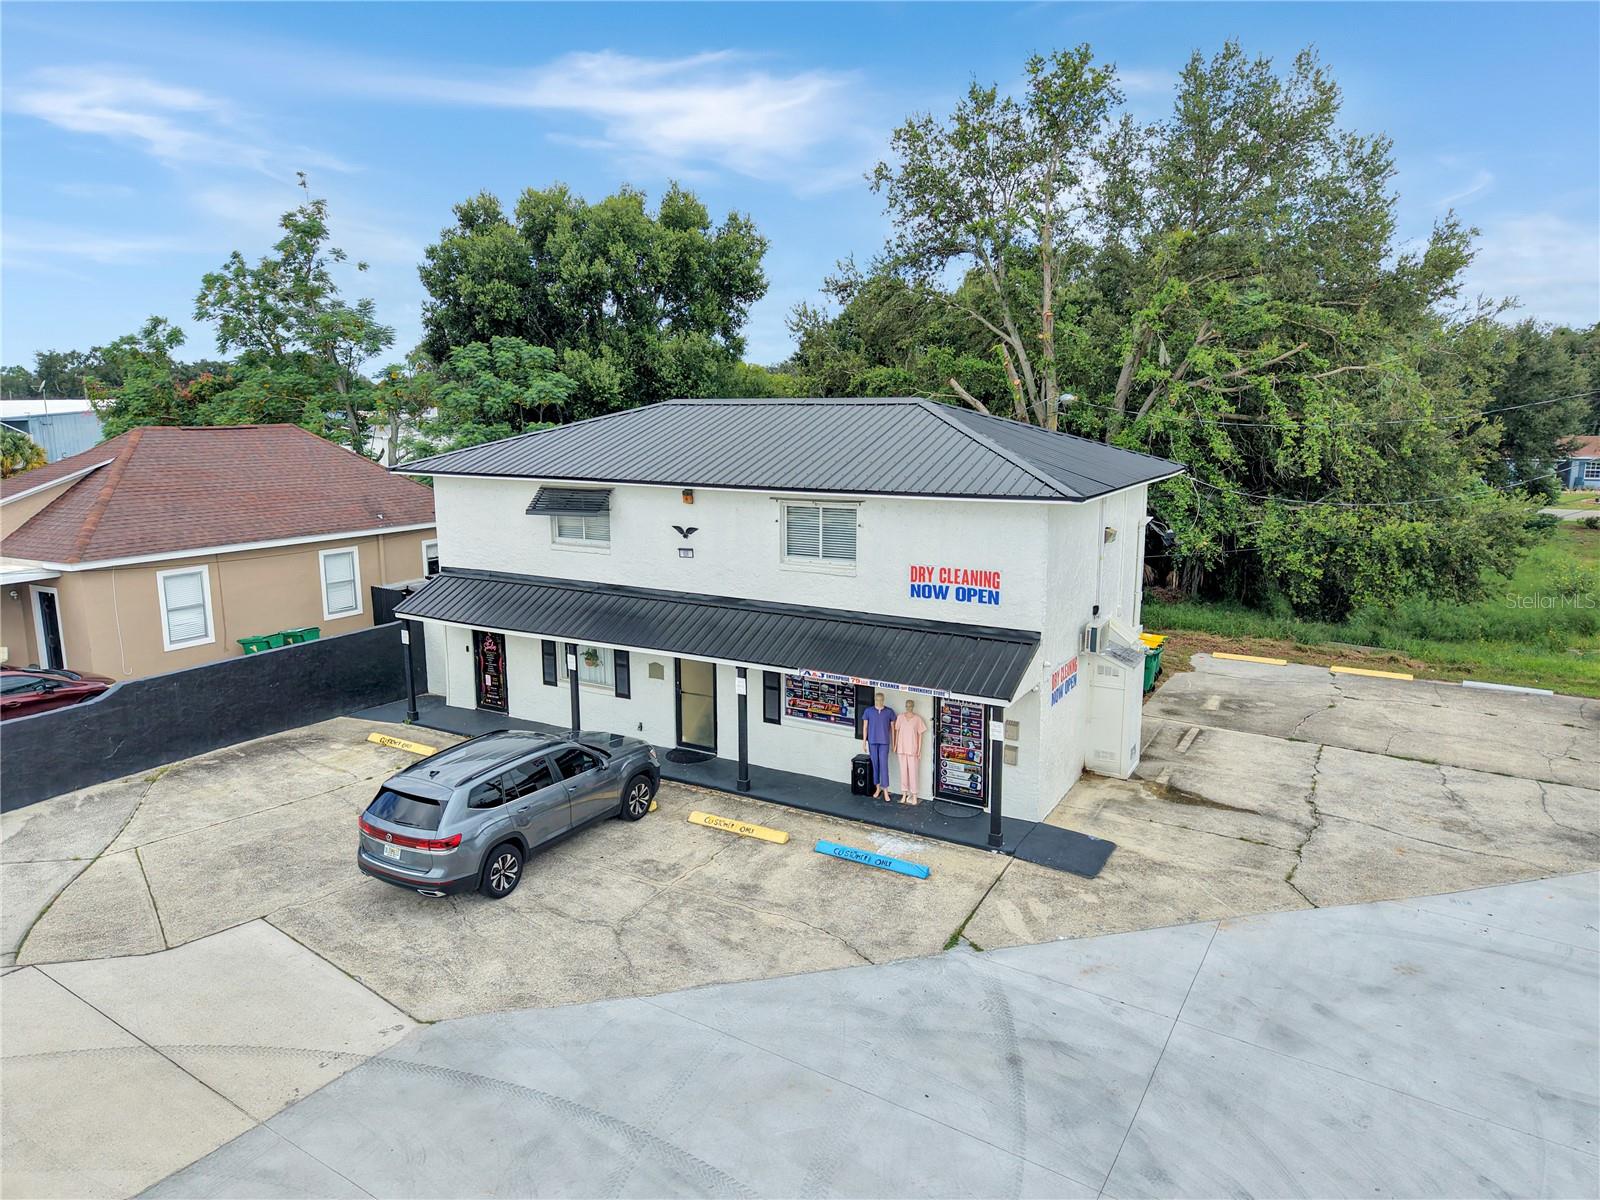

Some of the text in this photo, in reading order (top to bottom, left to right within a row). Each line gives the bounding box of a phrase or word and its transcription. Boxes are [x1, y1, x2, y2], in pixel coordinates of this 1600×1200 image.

[910, 565, 1000, 590] DRY CLEANING
[910, 583, 1000, 605] NOW OPEN
[880, 682, 900, 690] CLEANER
[908, 686, 933, 695] CONVENIENCE
[1064, 673, 1077, 695] OPEN
